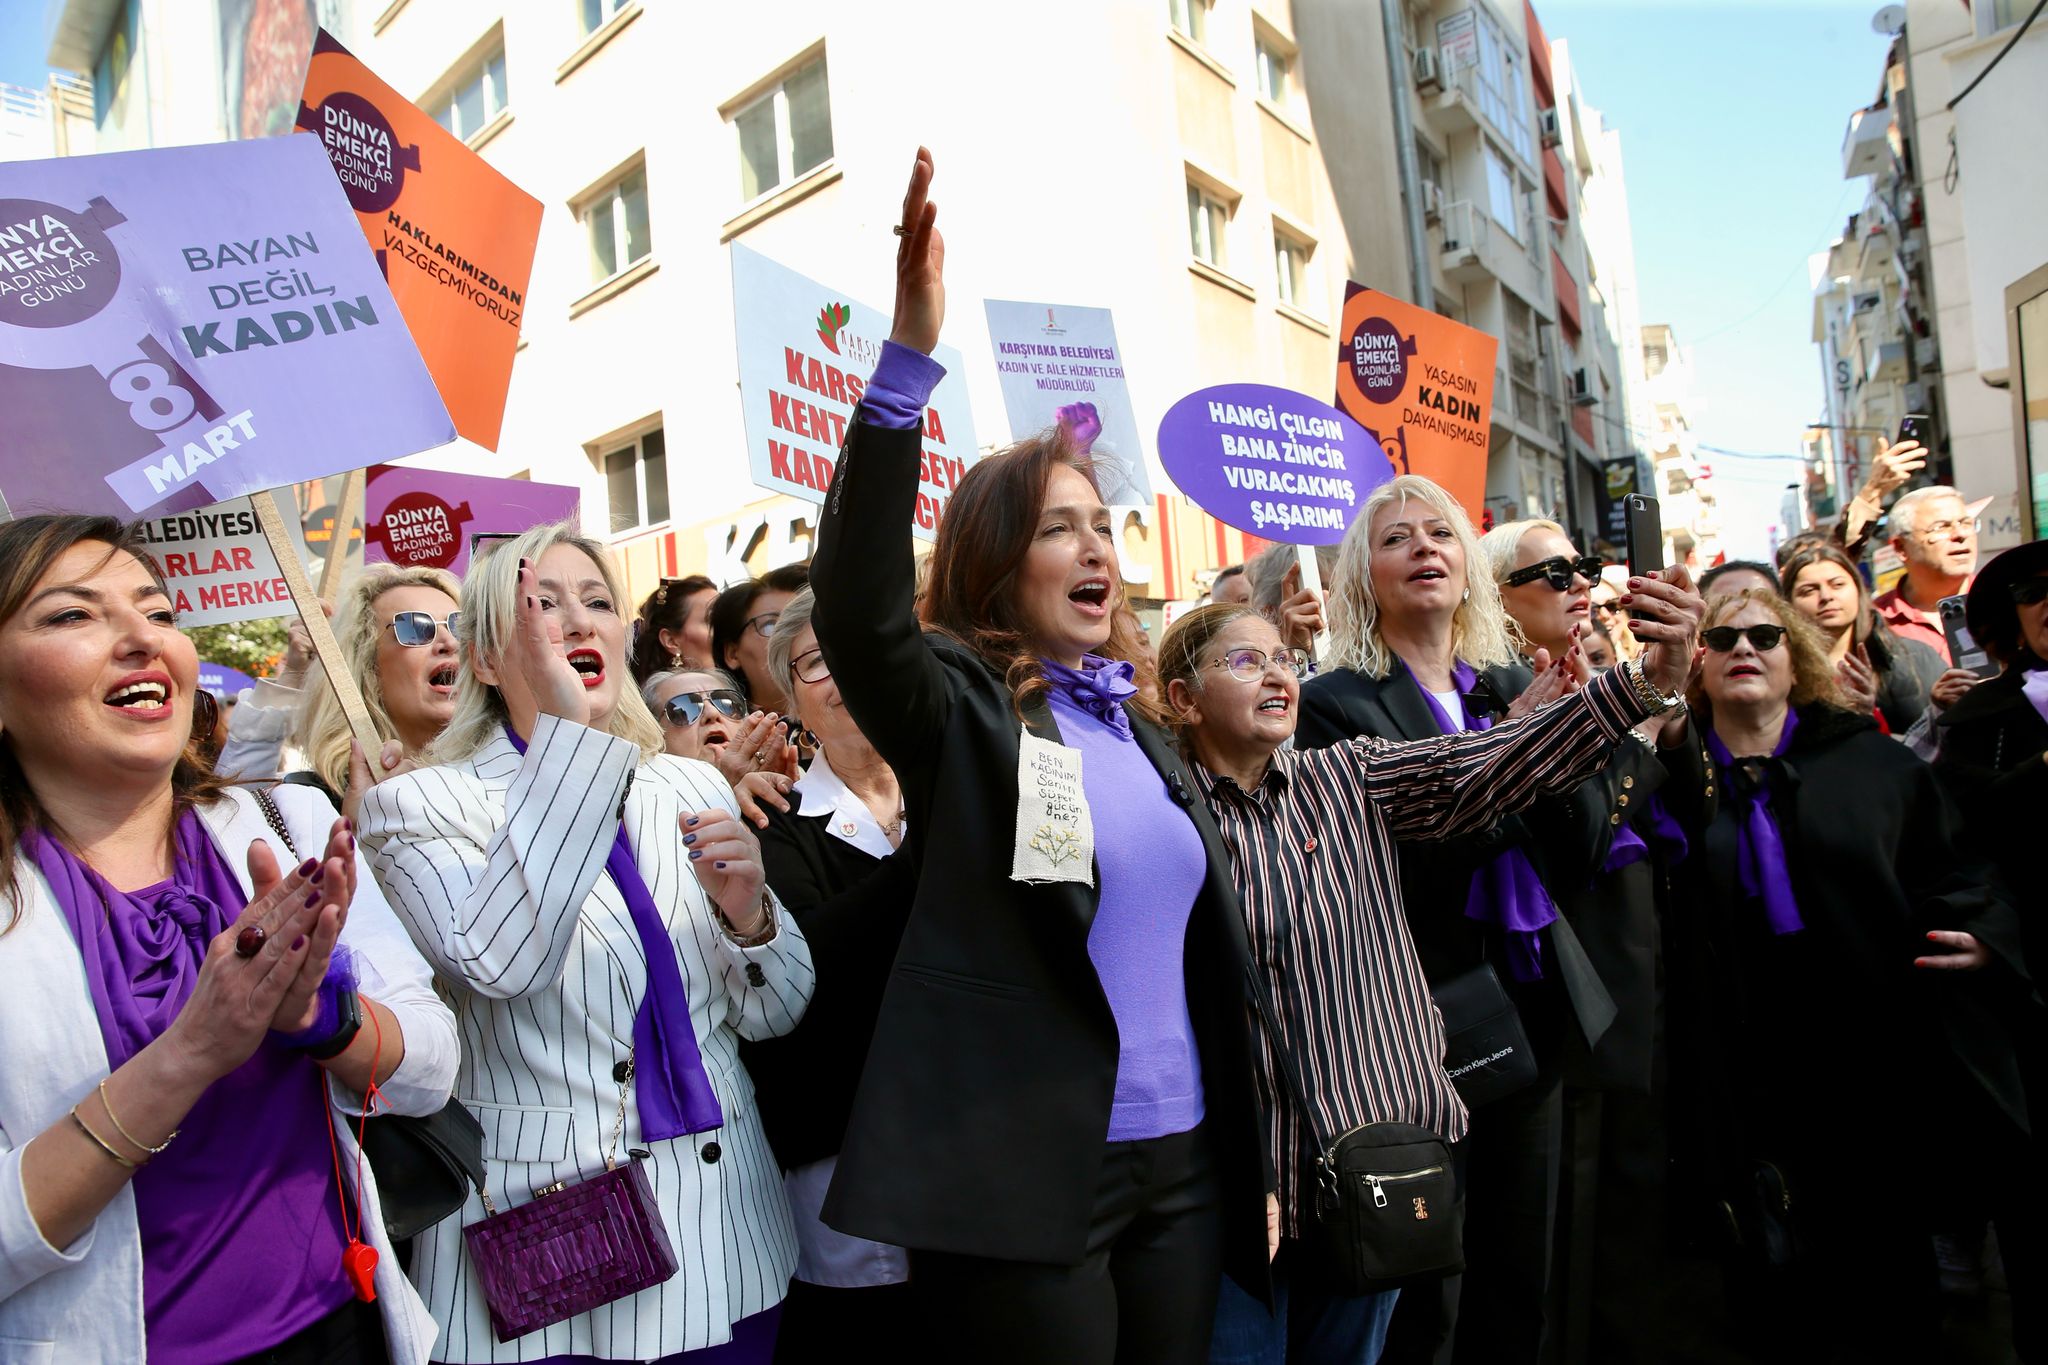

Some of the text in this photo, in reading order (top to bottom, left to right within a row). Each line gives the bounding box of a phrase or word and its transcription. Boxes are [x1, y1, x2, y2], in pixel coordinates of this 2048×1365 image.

[324, 105, 391, 150] DÜNYA
[324, 126, 391, 169] EMEKÇİ
[325, 146, 393, 185] KADINLAR
[339, 169, 377, 193] GÜNÜ
[0, 214, 69, 249] NYA
[181, 231, 320, 272] BAYAN
[388, 210, 522, 306] HAKLARIMIZDAN
[0, 251, 100, 297] ADINLAR
[20, 274, 86, 307] GÜNÜ
[208, 268, 336, 310] DEĞİL,
[383, 229, 520, 328] VAZGEÇMİYORUZ
[181, 295, 379, 359] KADIN
[1354, 333, 1398, 350] DÜNYA
[999, 342, 1115, 360] KARŞIYAKA BELEDİYESİ
[1356, 347, 1399, 366] EMEKÇİ
[997, 361, 1125, 379] KADIN VE AİLE HİZMETLERİ
[1036, 378, 1095, 392] MÜDÜRLÜĞÜ
[1357, 364, 1402, 377] KADINLAR
[1367, 376, 1393, 388] GÜNÜ
[1424, 363, 1477, 396] YAŞASIN
[108, 361, 196, 431] 8
[1419, 385, 1481, 424] KADIN
[769, 389, 846, 449] KENT
[1208, 401, 1344, 441] HANGİ ÇILGIN
[1403, 408, 1487, 448] DAYANIŞMASI
[143, 409, 257, 494] MART
[767, 439, 837, 494] KAD
[1221, 433, 1347, 470] BANA ZİNCİR
[1223, 466, 1355, 506] VURACAKMIŞ
[385, 505, 447, 528] DÜNYA
[389, 516, 450, 542] EMEKÇİ
[1250, 500, 1345, 531] ŞAŞARIM!
[393, 532, 454, 553] KADINLAR
[409, 545, 443, 561] GÜNÜ
[175, 577, 294, 614] A MERKE
[1030, 760, 1076, 782] KADINIM
[1038, 751, 1063, 768] BEN
[1046, 799, 1082, 816] gücün
[1054, 813, 1079, 828] ne?
[1447, 1046, 1514, 1078] Calvin Klein Jeans
